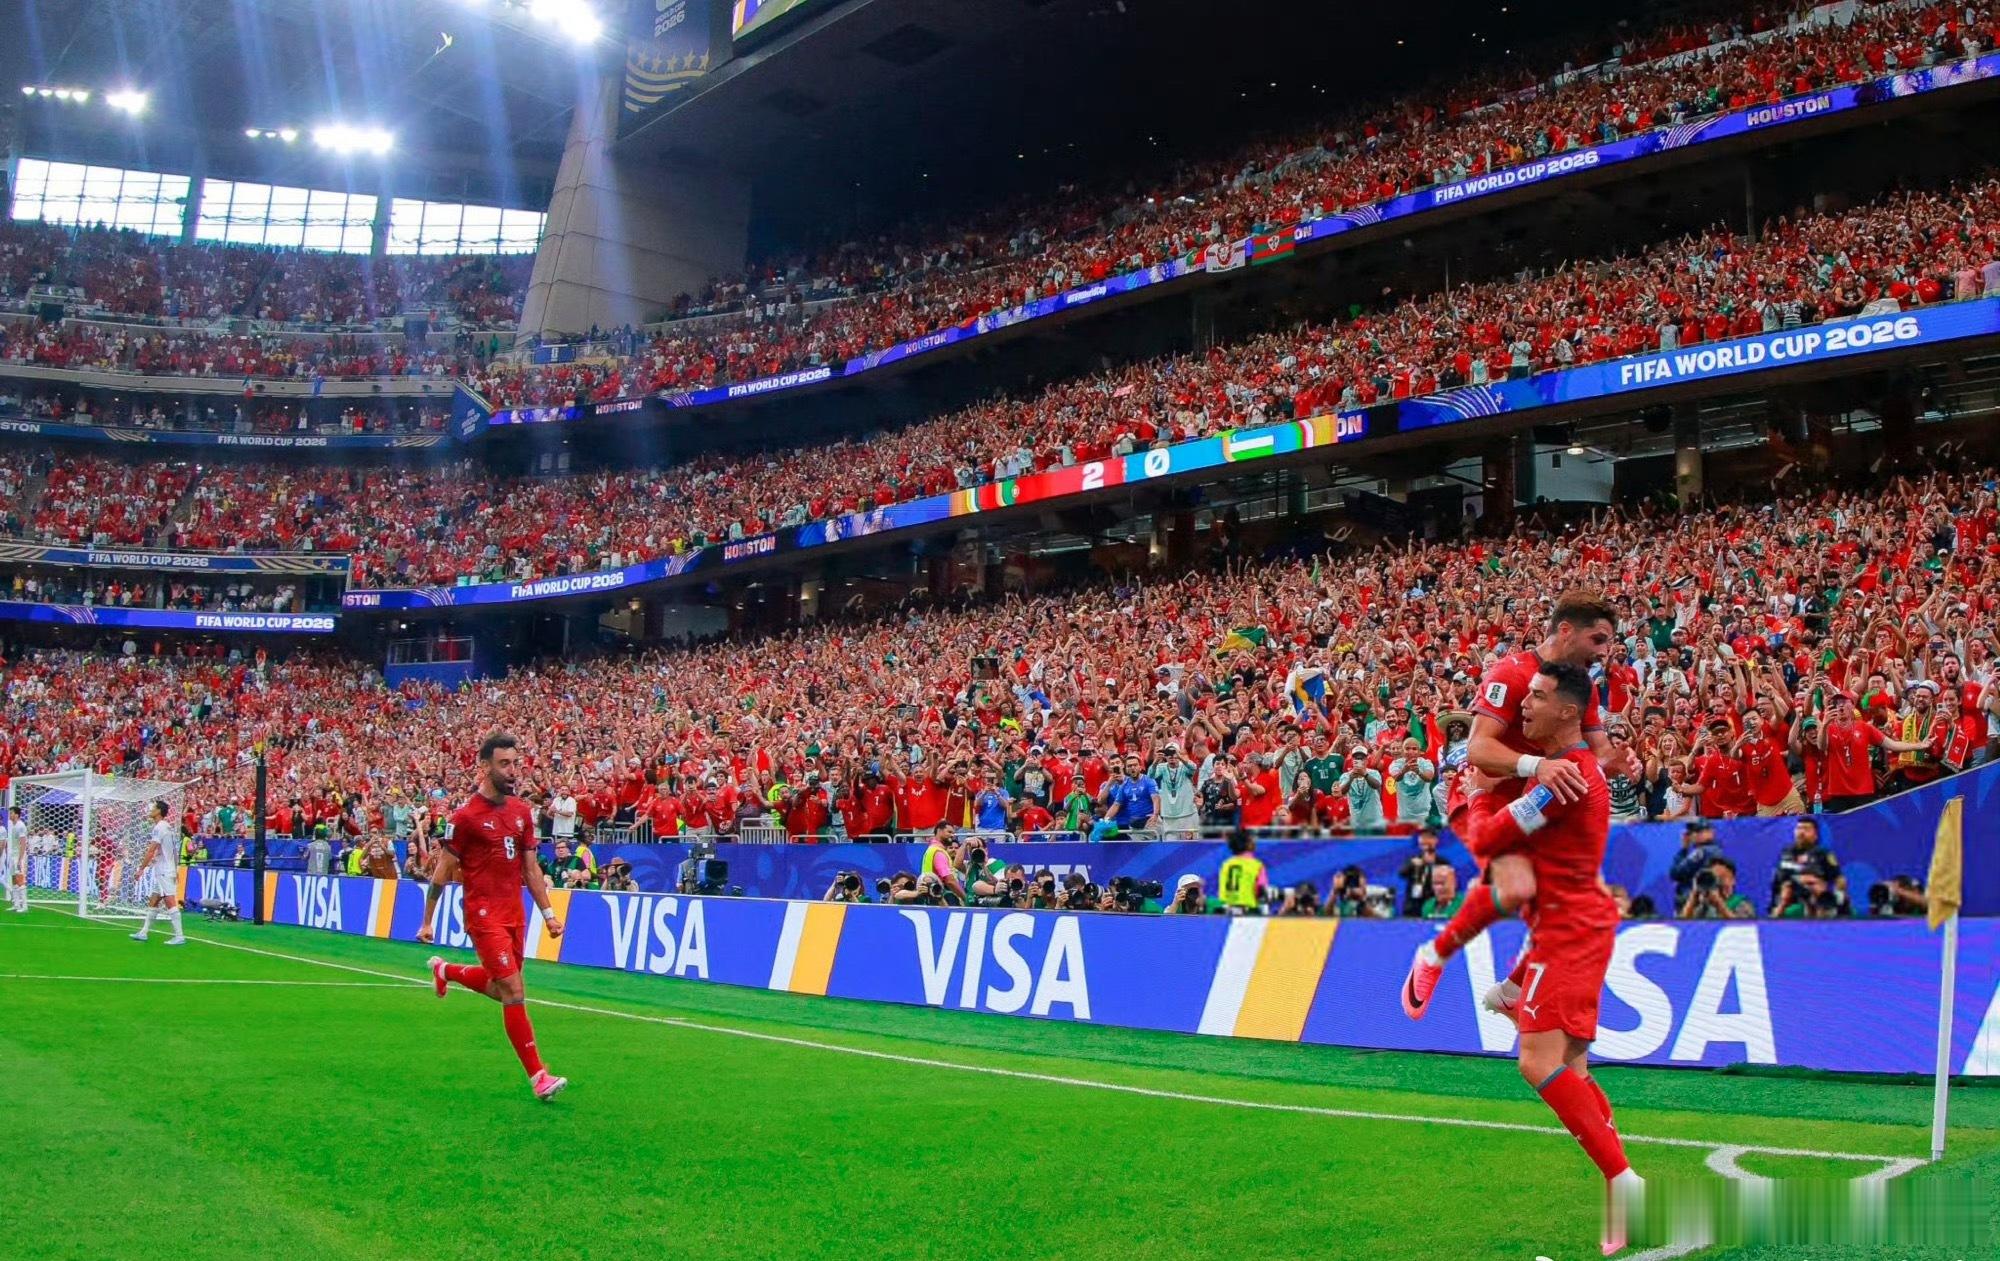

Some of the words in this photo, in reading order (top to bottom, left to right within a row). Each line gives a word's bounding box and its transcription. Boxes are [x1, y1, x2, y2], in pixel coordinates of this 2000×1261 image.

[655, 10, 686, 37] 2026
[1747, 95, 1830, 126] HOUSTON
[1435, 187, 1464, 203] FIFA
[1466, 173, 1516, 195] WORLD
[1517, 164, 1546, 181] CUP
[1547, 151, 1599, 175] 2026
[905, 331, 948, 354] HOUSTON
[1620, 362, 1673, 385] FIFA
[1674, 341, 1766, 376] WORLD
[1768, 332, 1822, 361] CUP
[1825, 316, 1919, 351] 2026
[728, 385, 748, 397] FIFA
[748, 377, 779, 393] WORLD
[780, 374, 799, 387] CUP
[798, 367, 831, 383] 2026
[595, 400, 643, 415] HOUSTON
[218, 435, 239, 445] FIFA
[240, 436, 274, 446] WORLD
[274, 438, 294, 446] CUP
[294, 437, 328, 447] 2026
[1081, 461, 1105, 491] 2
[1143, 447, 1170, 478] 0
[88, 552, 111, 563] FIFA
[112, 553, 150, 565] WORLD
[150, 554, 171, 566] CUP
[172, 556, 209, 567] 2026
[724, 536, 776, 560] HOUSTON
[534, 579, 570, 596] WORLD
[570, 576, 592, 591] CUP
[592, 571, 624, 589] 2026
[196, 615, 222, 627] FIFA
[222, 616, 266, 628] WORLD
[266, 617, 291, 629] CUP
[291, 617, 335, 629] 2026
[197, 868, 236, 907] VISA
[292, 874, 343, 931] VISA
[601, 894, 709, 979] VISA
[899, 909, 1092, 1020] VISA
[1436, 923, 1778, 1065] VSA
[1524, 962, 1546, 1002] 7
